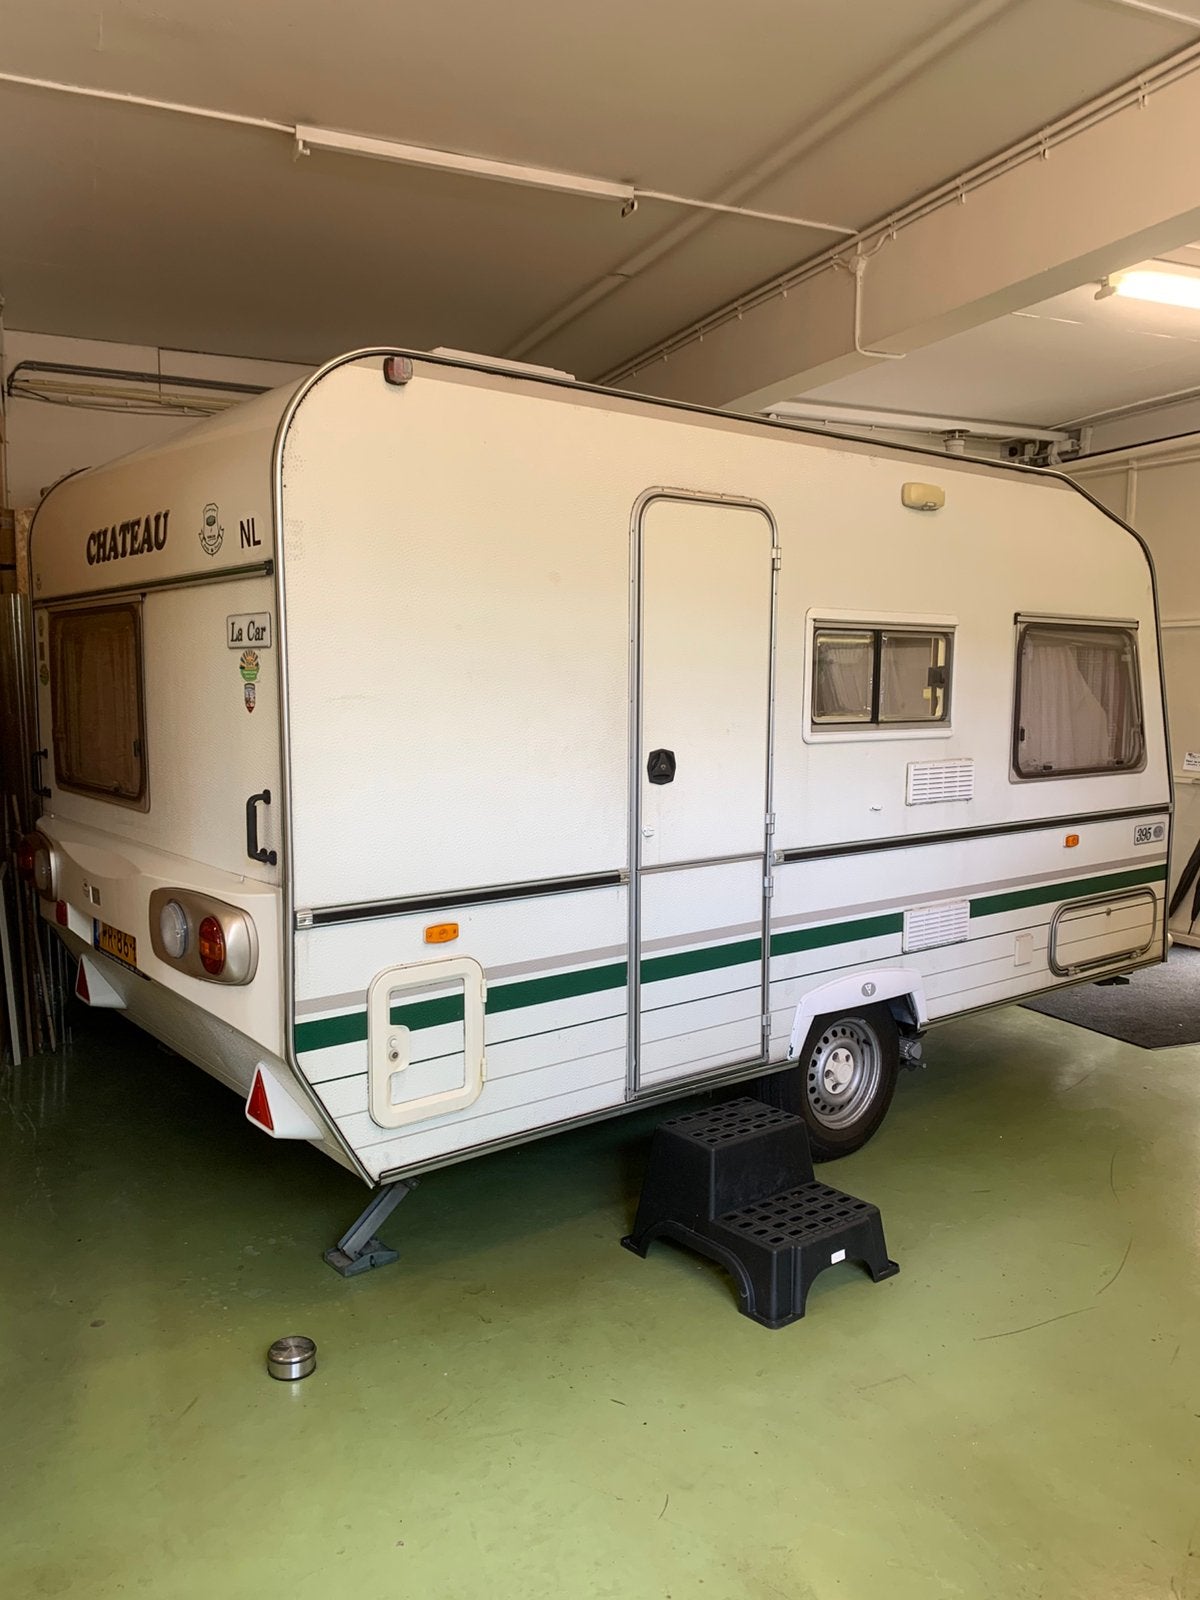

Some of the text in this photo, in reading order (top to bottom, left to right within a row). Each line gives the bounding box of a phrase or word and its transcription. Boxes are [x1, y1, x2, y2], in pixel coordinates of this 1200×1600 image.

[86, 509, 170, 565] CHATEAU
[240, 518, 261, 548] NL
[230, 621, 266, 642] La Car
[1136, 827, 1152, 842] 395
